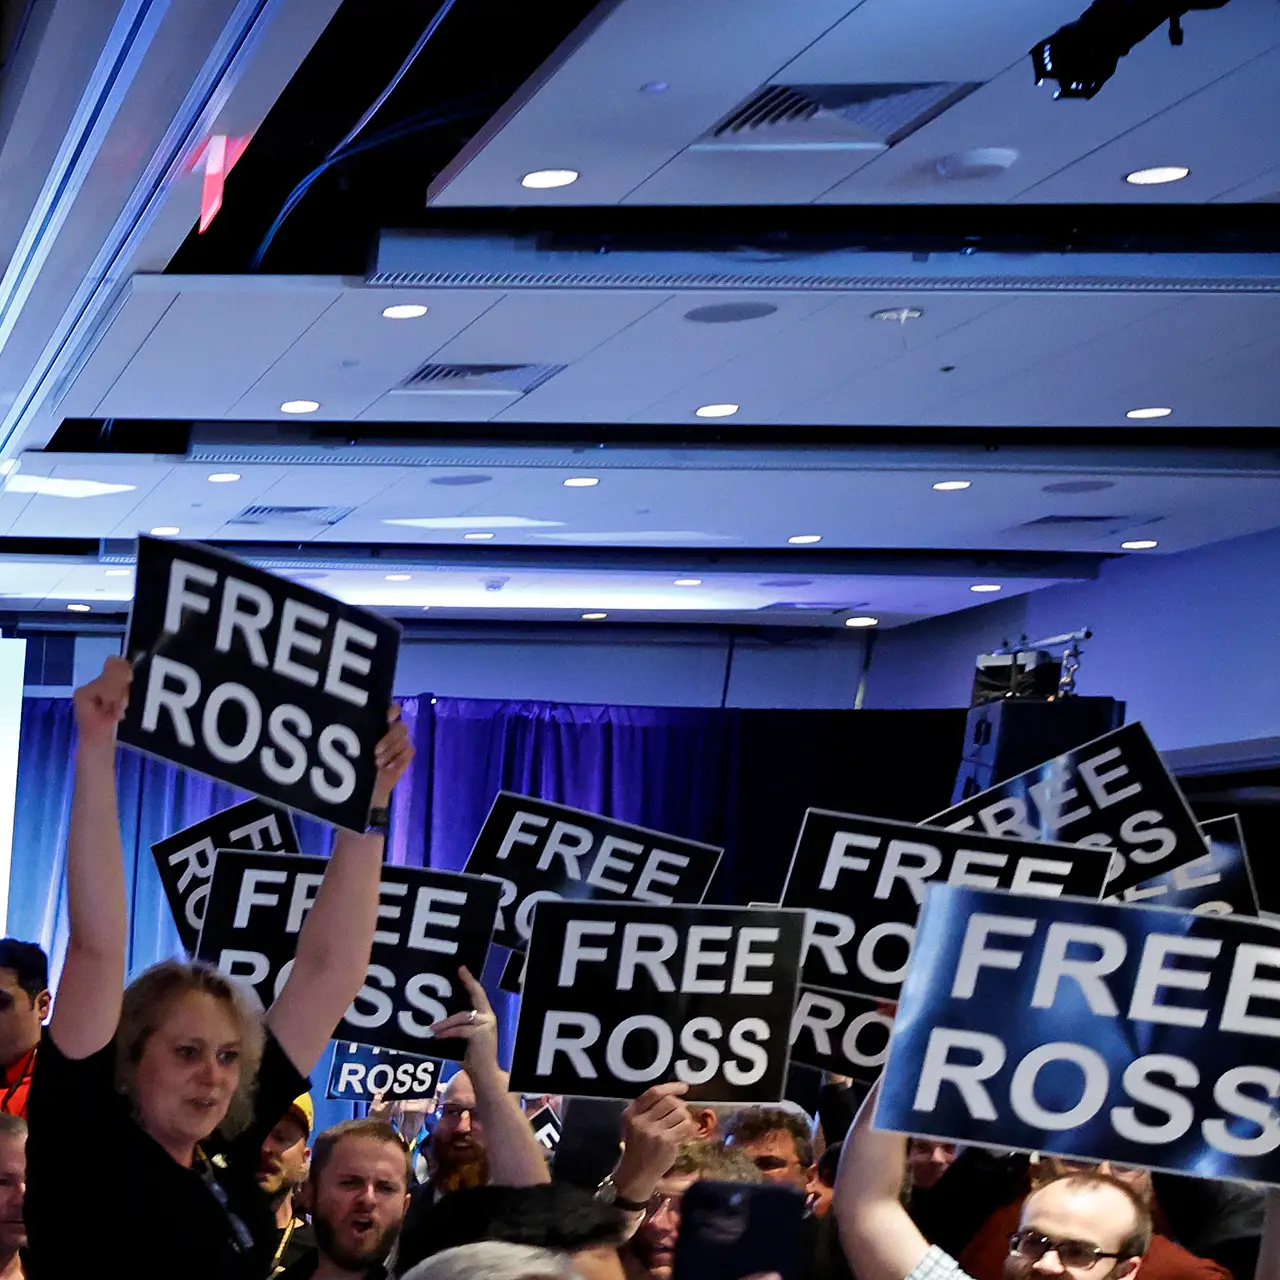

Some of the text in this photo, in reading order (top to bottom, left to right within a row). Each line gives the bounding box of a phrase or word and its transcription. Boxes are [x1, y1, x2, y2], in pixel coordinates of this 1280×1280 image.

[163, 557, 378, 708] FREE
[141, 653, 362, 804] ROSS
[944, 746, 1142, 838] REE
[496, 810, 690, 905] FREE
[558, 919, 780, 996] FREE
[800, 909, 917, 985] RO
[950, 912, 1280, 1038] FREE
[536, 1010, 771, 1086] ROSS
[790, 992, 896, 1068] RO
[338, 1062, 435, 1095] ROSS
[912, 1026, 1280, 1157] ROSS
